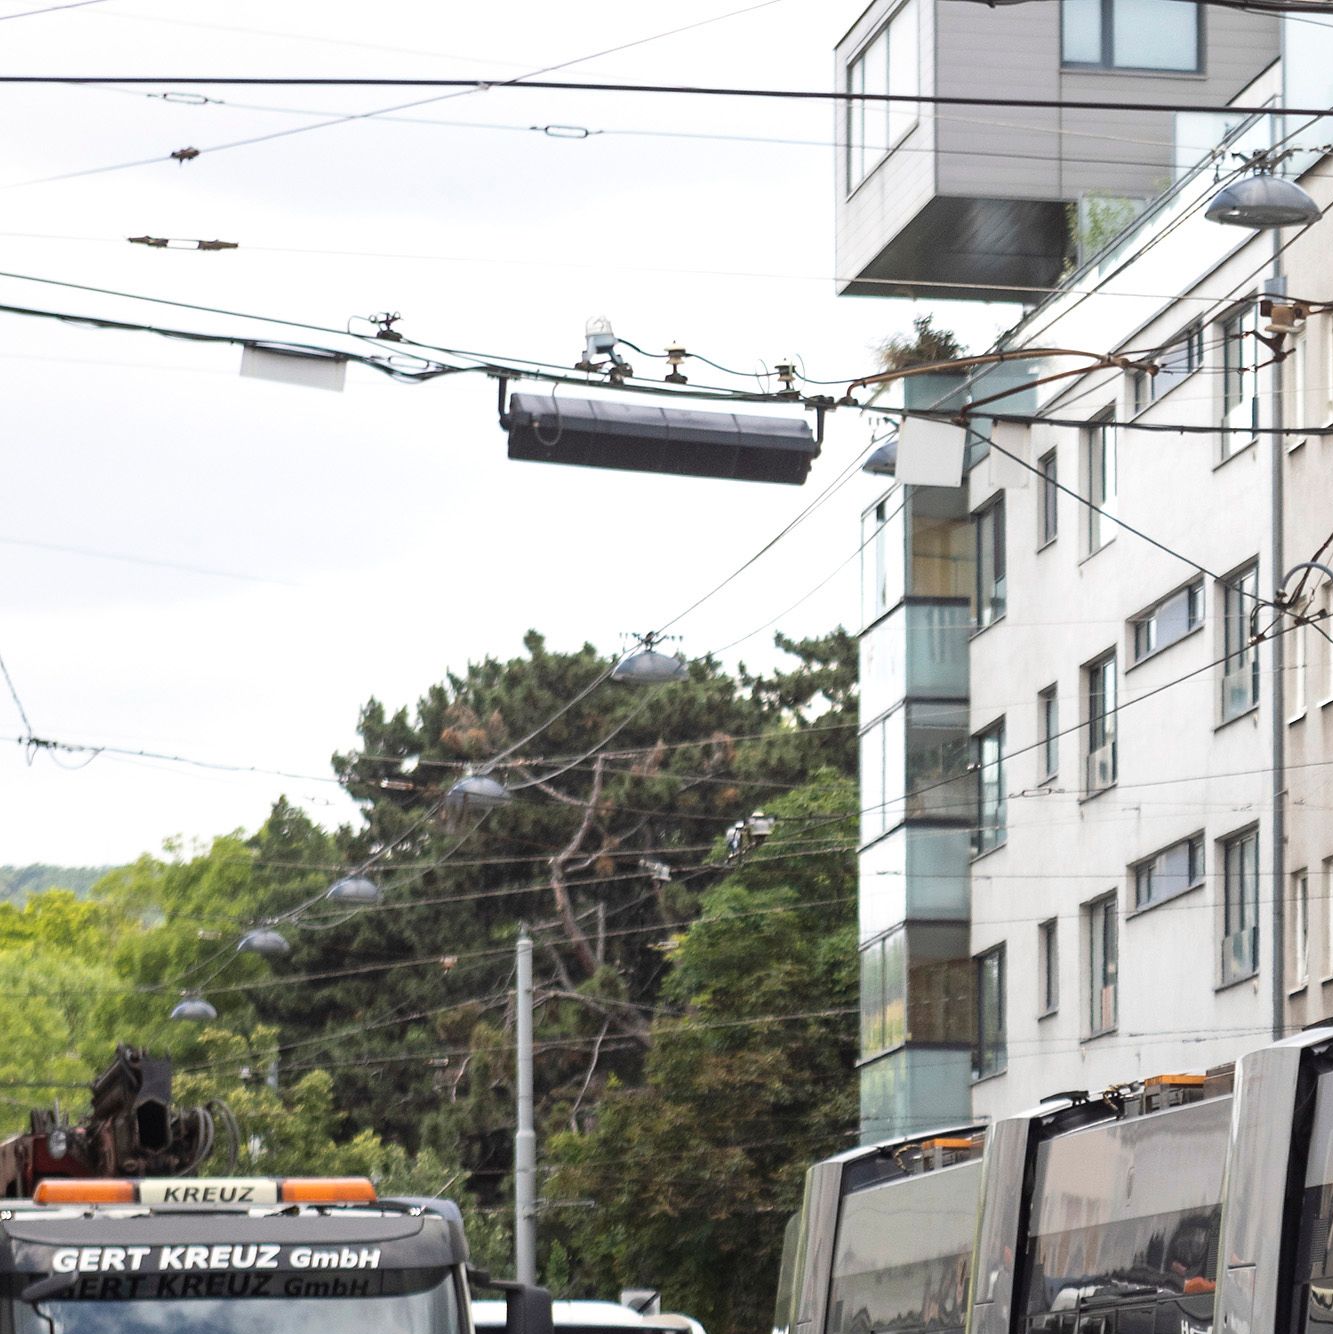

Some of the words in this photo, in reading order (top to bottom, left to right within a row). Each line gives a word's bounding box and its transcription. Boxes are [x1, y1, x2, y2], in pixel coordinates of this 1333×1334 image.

[163, 1186, 255, 1202] KREUZ
[52, 1247, 151, 1272] GERT
[158, 1245, 281, 1270] KREUZ
[289, 1248, 381, 1270] GmbH
[64, 1273, 148, 1299] ERT
